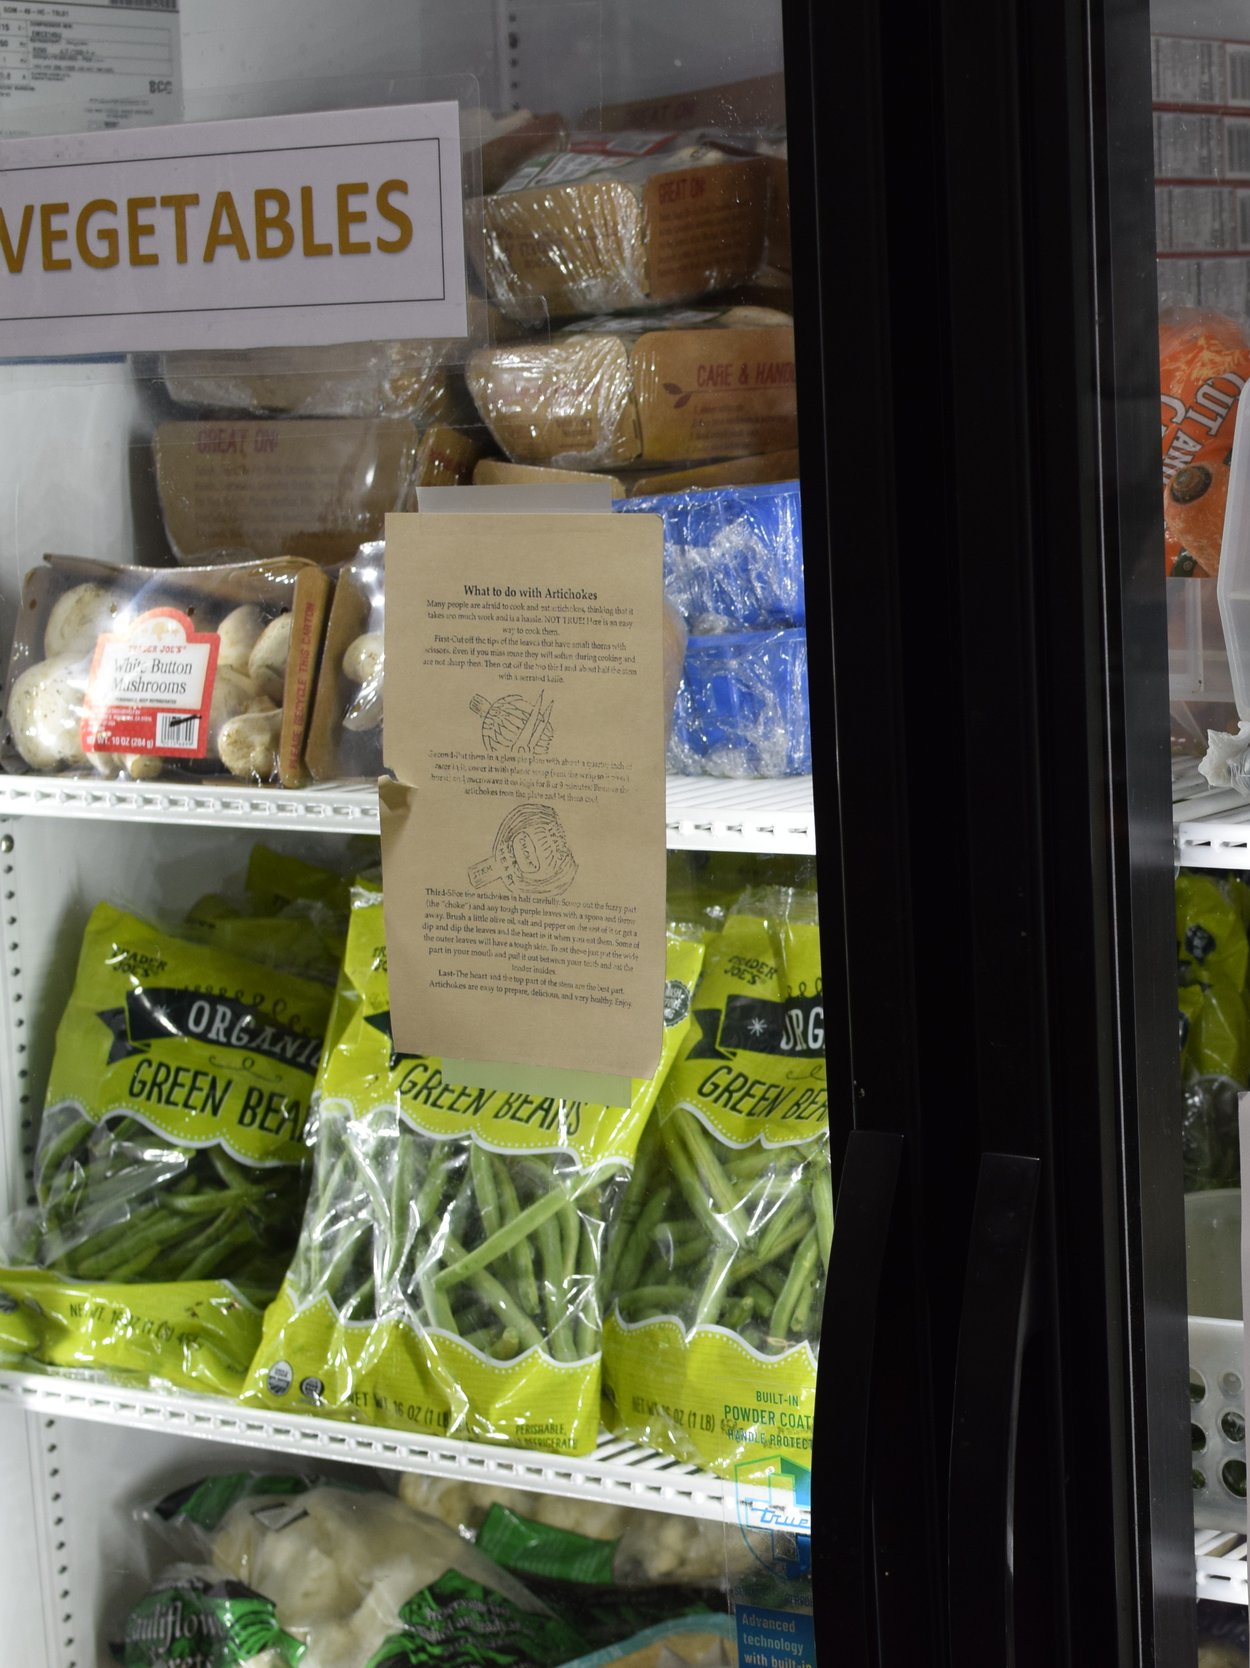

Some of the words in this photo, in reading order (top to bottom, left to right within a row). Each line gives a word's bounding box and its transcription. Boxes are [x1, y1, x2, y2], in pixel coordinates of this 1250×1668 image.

[0, 178, 414, 274] VEGETABLES
[697, 363, 734, 388] CARE
[464, 585, 490, 596] What
[493, 587, 502, 597] to
[504, 586, 517, 597] do
[519, 587, 542, 598] with
[544, 588, 598, 600] Artichokes
[113, 657, 148, 675] White
[151, 657, 193, 675] Button
[301, 645, 310, 673] THIS
[111, 676, 187, 694] Mushrooms
[128, 1059, 233, 1118] GREEN
[237, 1086, 304, 1143] BEA
[398, 1062, 490, 1117] GREEN
[492, 1089, 588, 1137] BEANS
[697, 1065, 794, 1118] GREEN
[780, 1087, 828, 1123] BEA
[756, 1391, 799, 1407] BUILT-IN
[700, 1413, 715, 1433] LB)
[724, 1404, 776, 1426] POWDER
[727, 1429, 766, 1445] HANDLE
[751, 1507, 812, 1528] true
[742, 1613, 796, 1633] Advanced
[743, 1633, 804, 1656] technology
[744, 1652, 768, 1667] with
